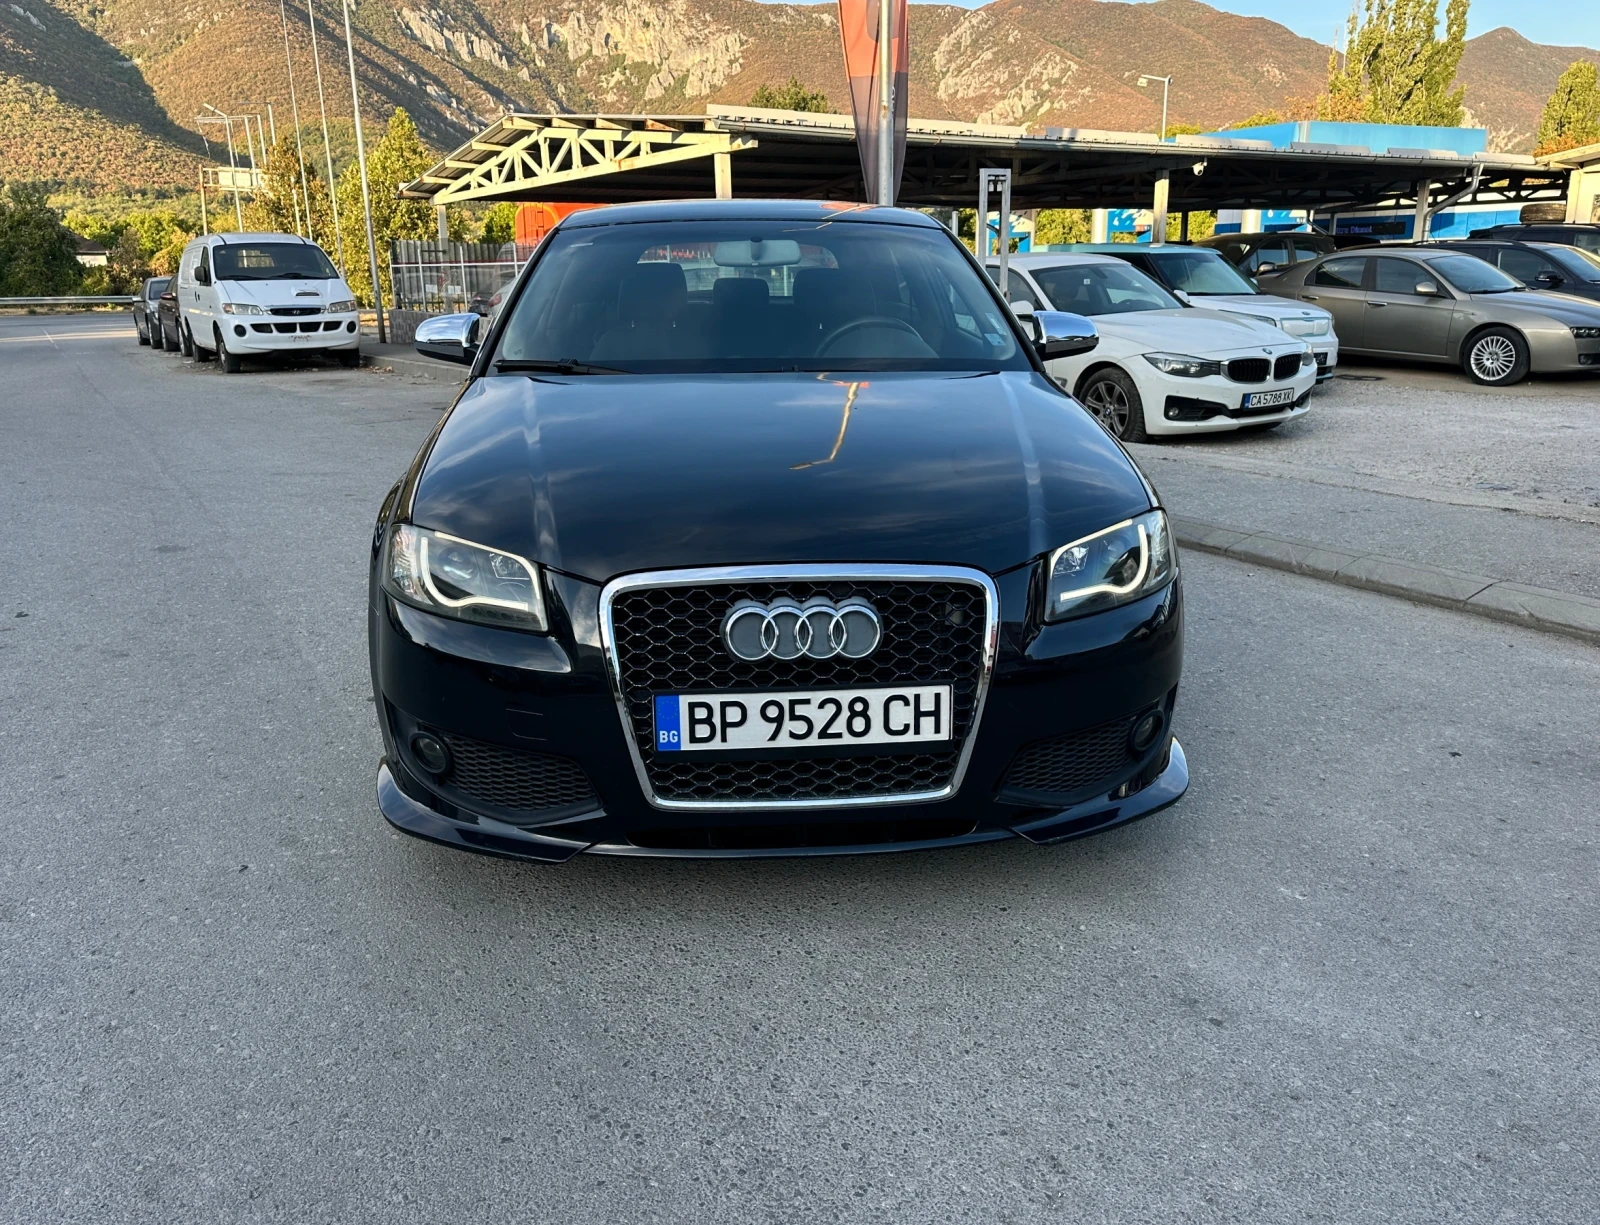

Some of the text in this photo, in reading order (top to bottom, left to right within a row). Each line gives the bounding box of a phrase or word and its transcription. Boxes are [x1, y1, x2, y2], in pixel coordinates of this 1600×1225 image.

[1250, 395, 1261, 406] CA
[1262, 393, 1282, 405] 5788
[687, 691, 942, 744] BP 9528 CH
[659, 730, 679, 743] BG
